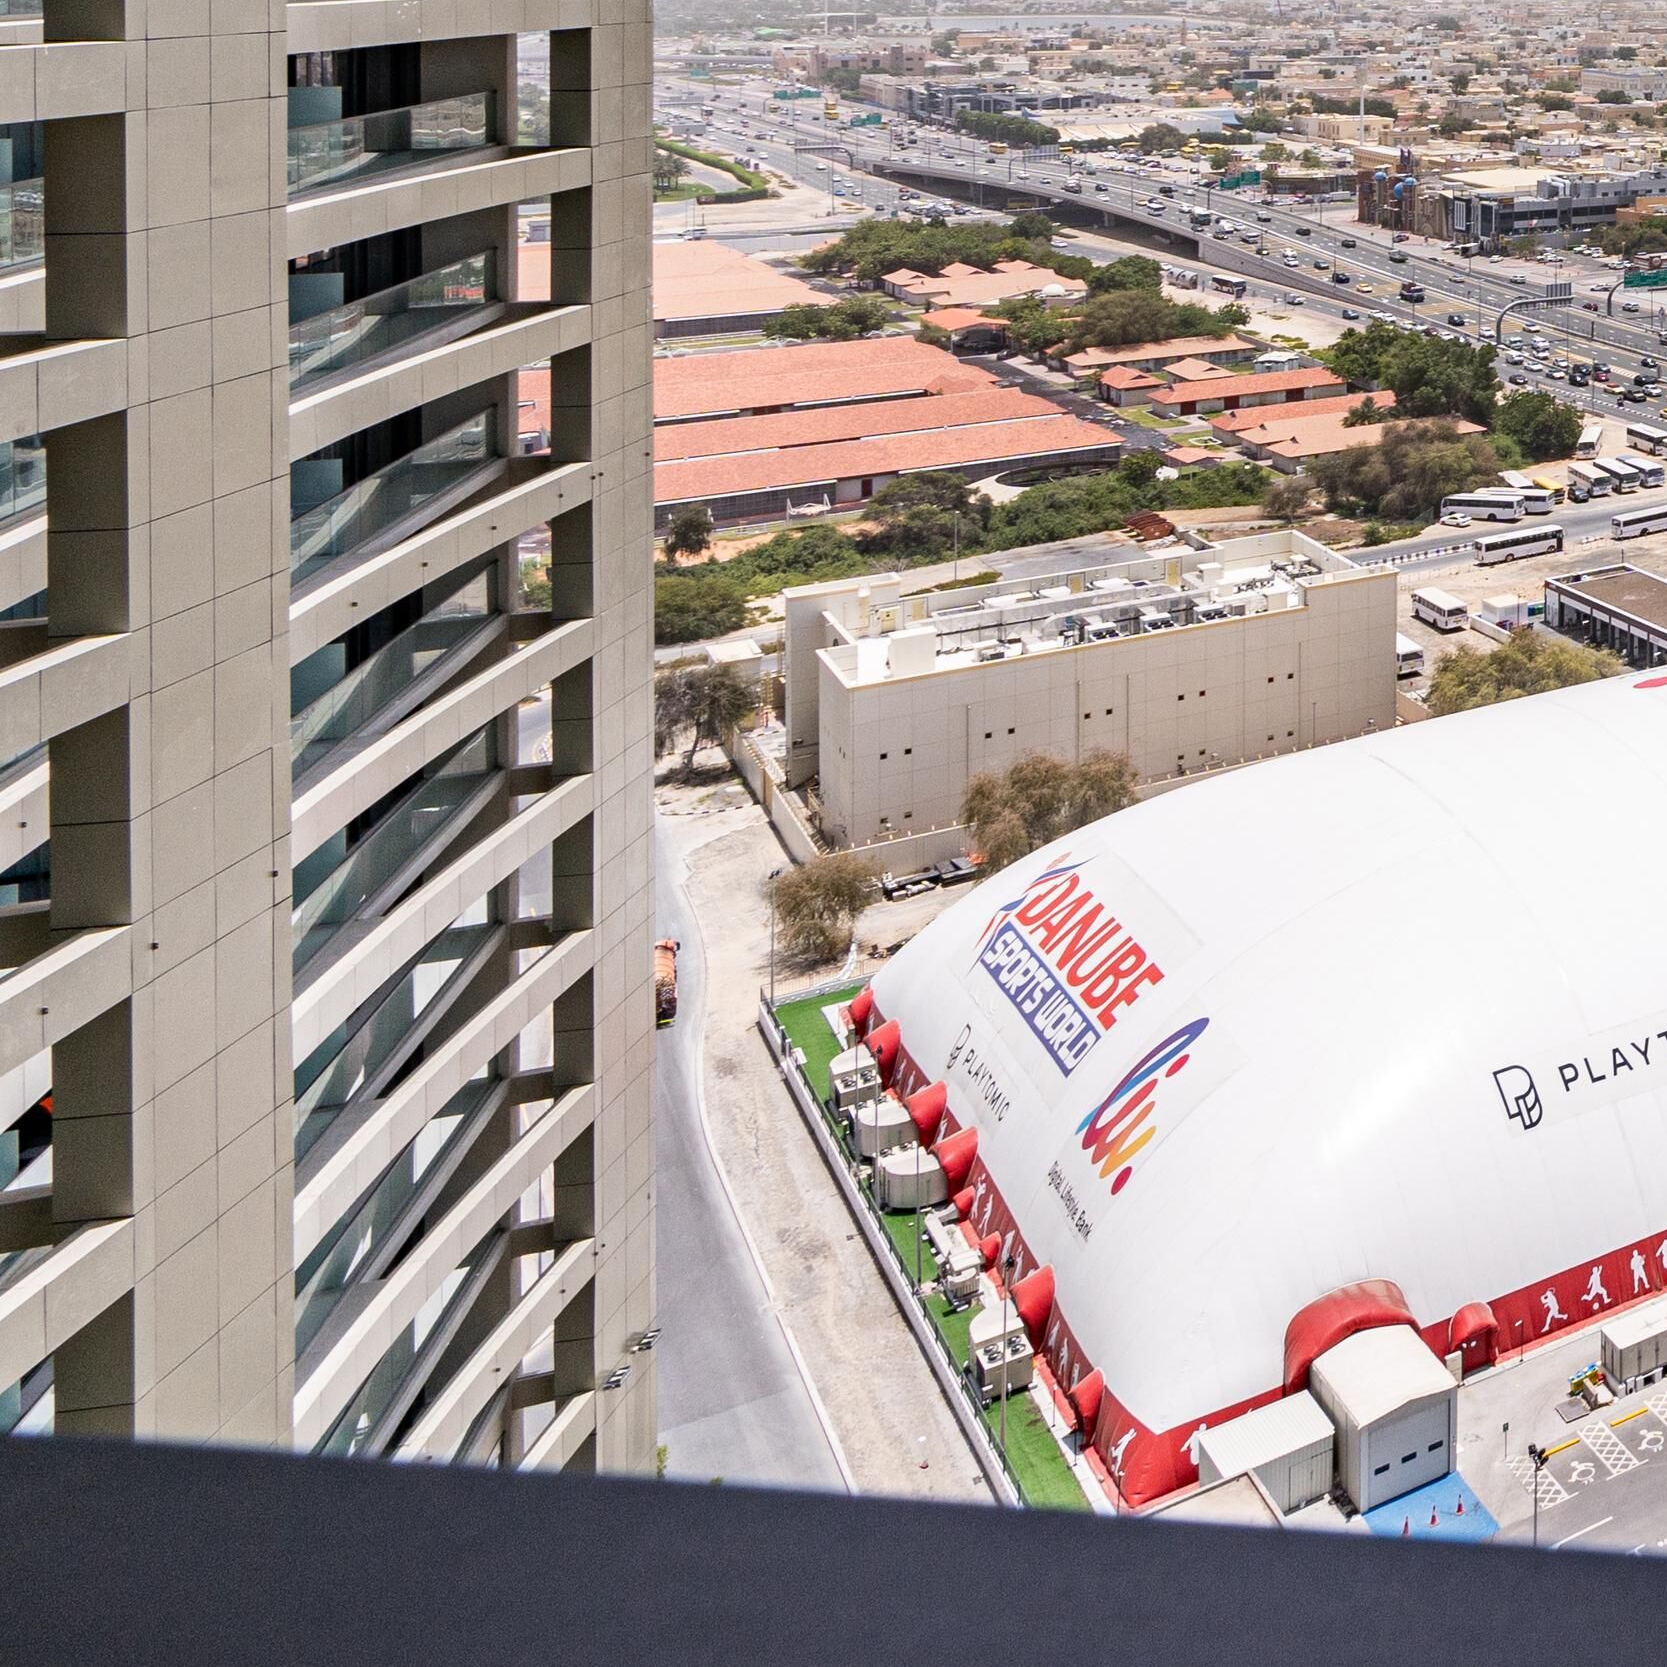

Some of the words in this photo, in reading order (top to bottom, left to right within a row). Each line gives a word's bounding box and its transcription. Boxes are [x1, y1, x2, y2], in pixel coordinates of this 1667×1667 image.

[984, 931, 1053, 1015] SPORTS
[1033, 993, 1101, 1070] WORLD
[1015, 872, 1165, 1032] DANUBE
[962, 1048, 1010, 1122] PLAYTOMIC
